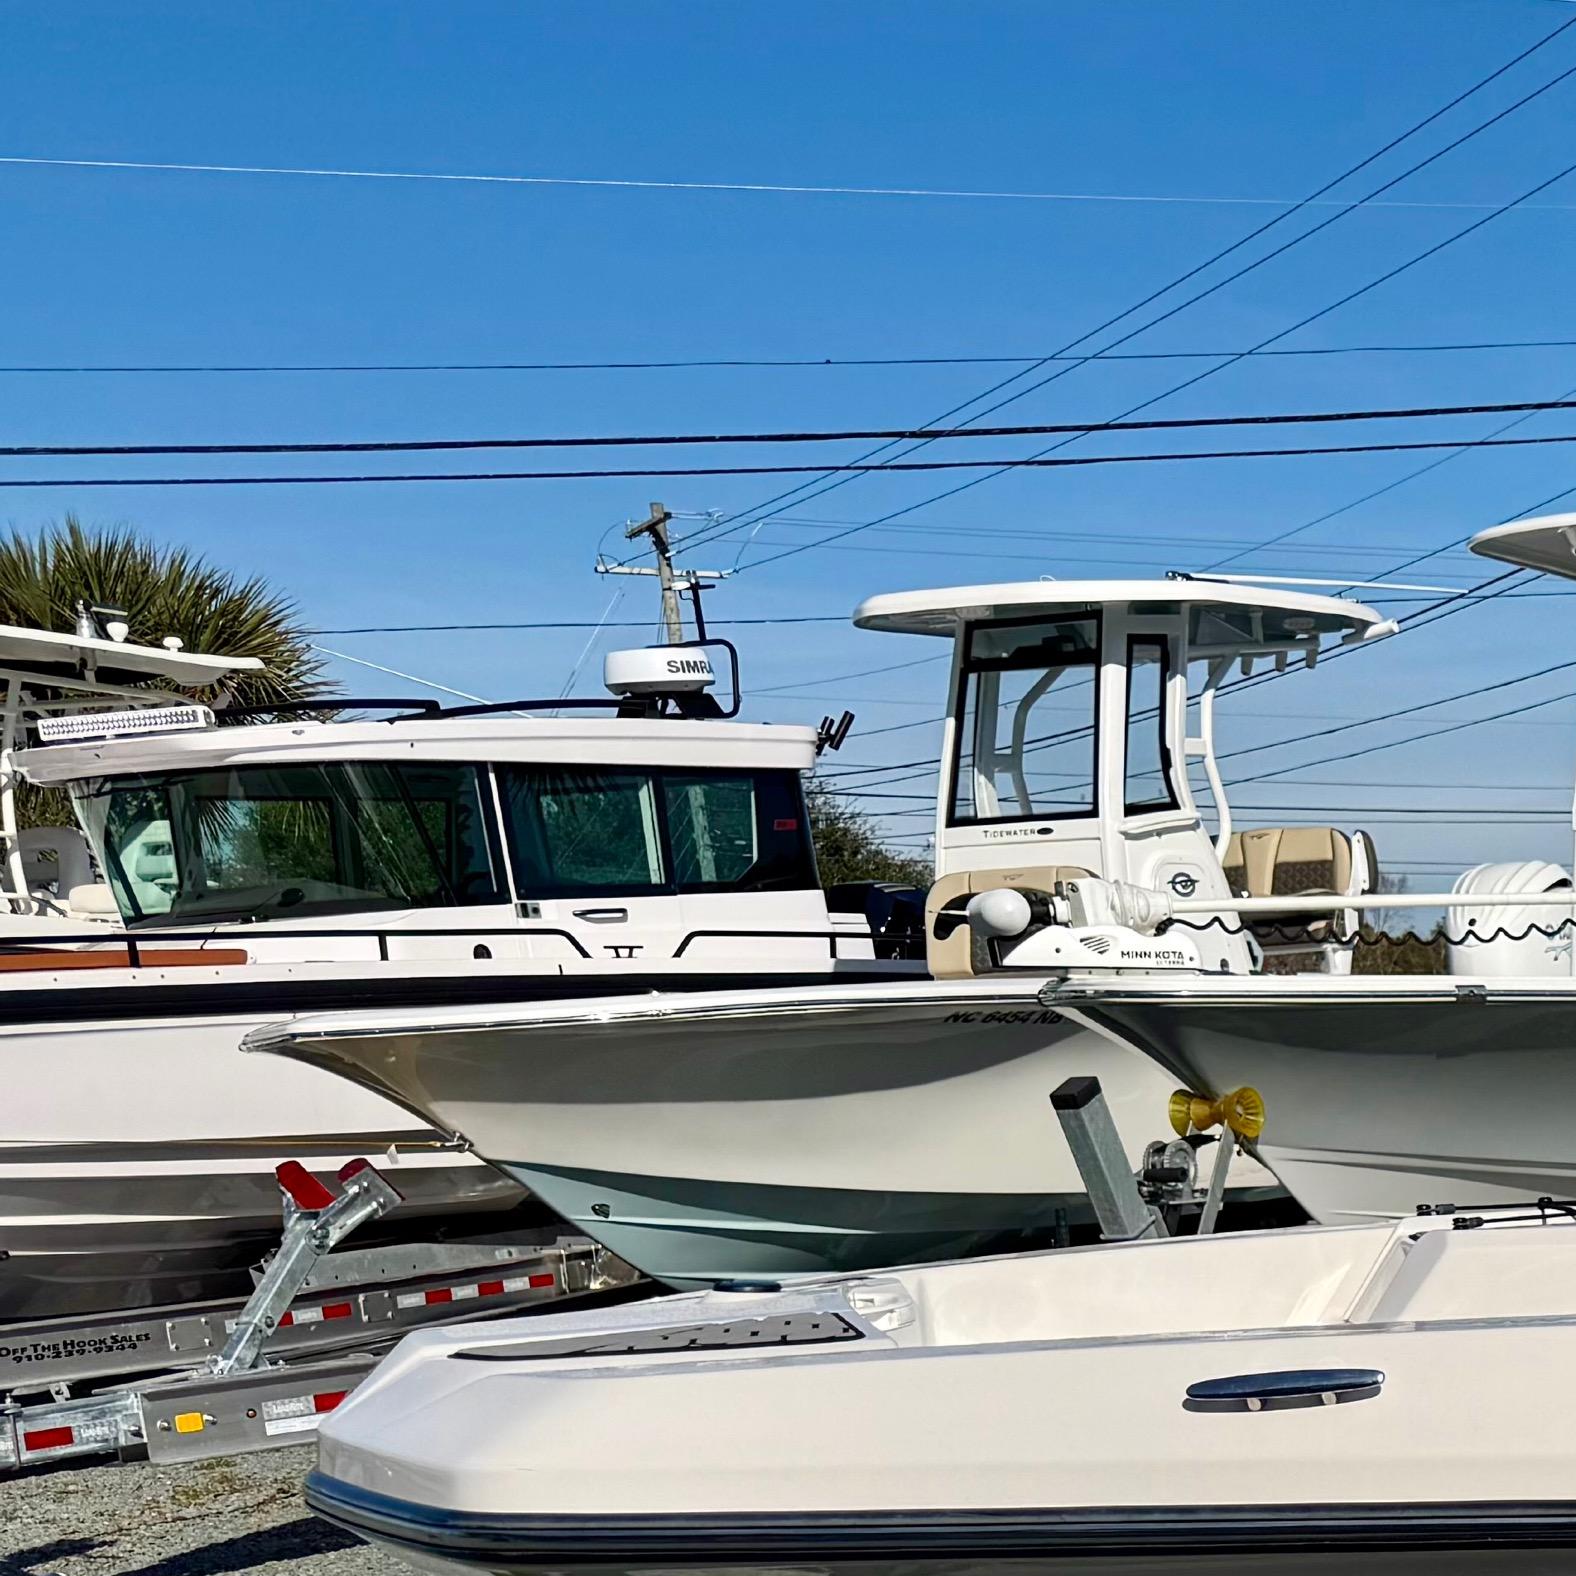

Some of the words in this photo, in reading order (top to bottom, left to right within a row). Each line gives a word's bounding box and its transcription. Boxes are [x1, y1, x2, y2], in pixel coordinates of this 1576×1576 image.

[1120, 950, 1151, 959] MINN
[1155, 950, 1184, 959] KOTA
[0, 1347, 27, 1358] OFF
[30, 1343, 60, 1354] THE
[63, 1338, 107, 1350] HOOK
[110, 1332, 151, 1344] SALES
